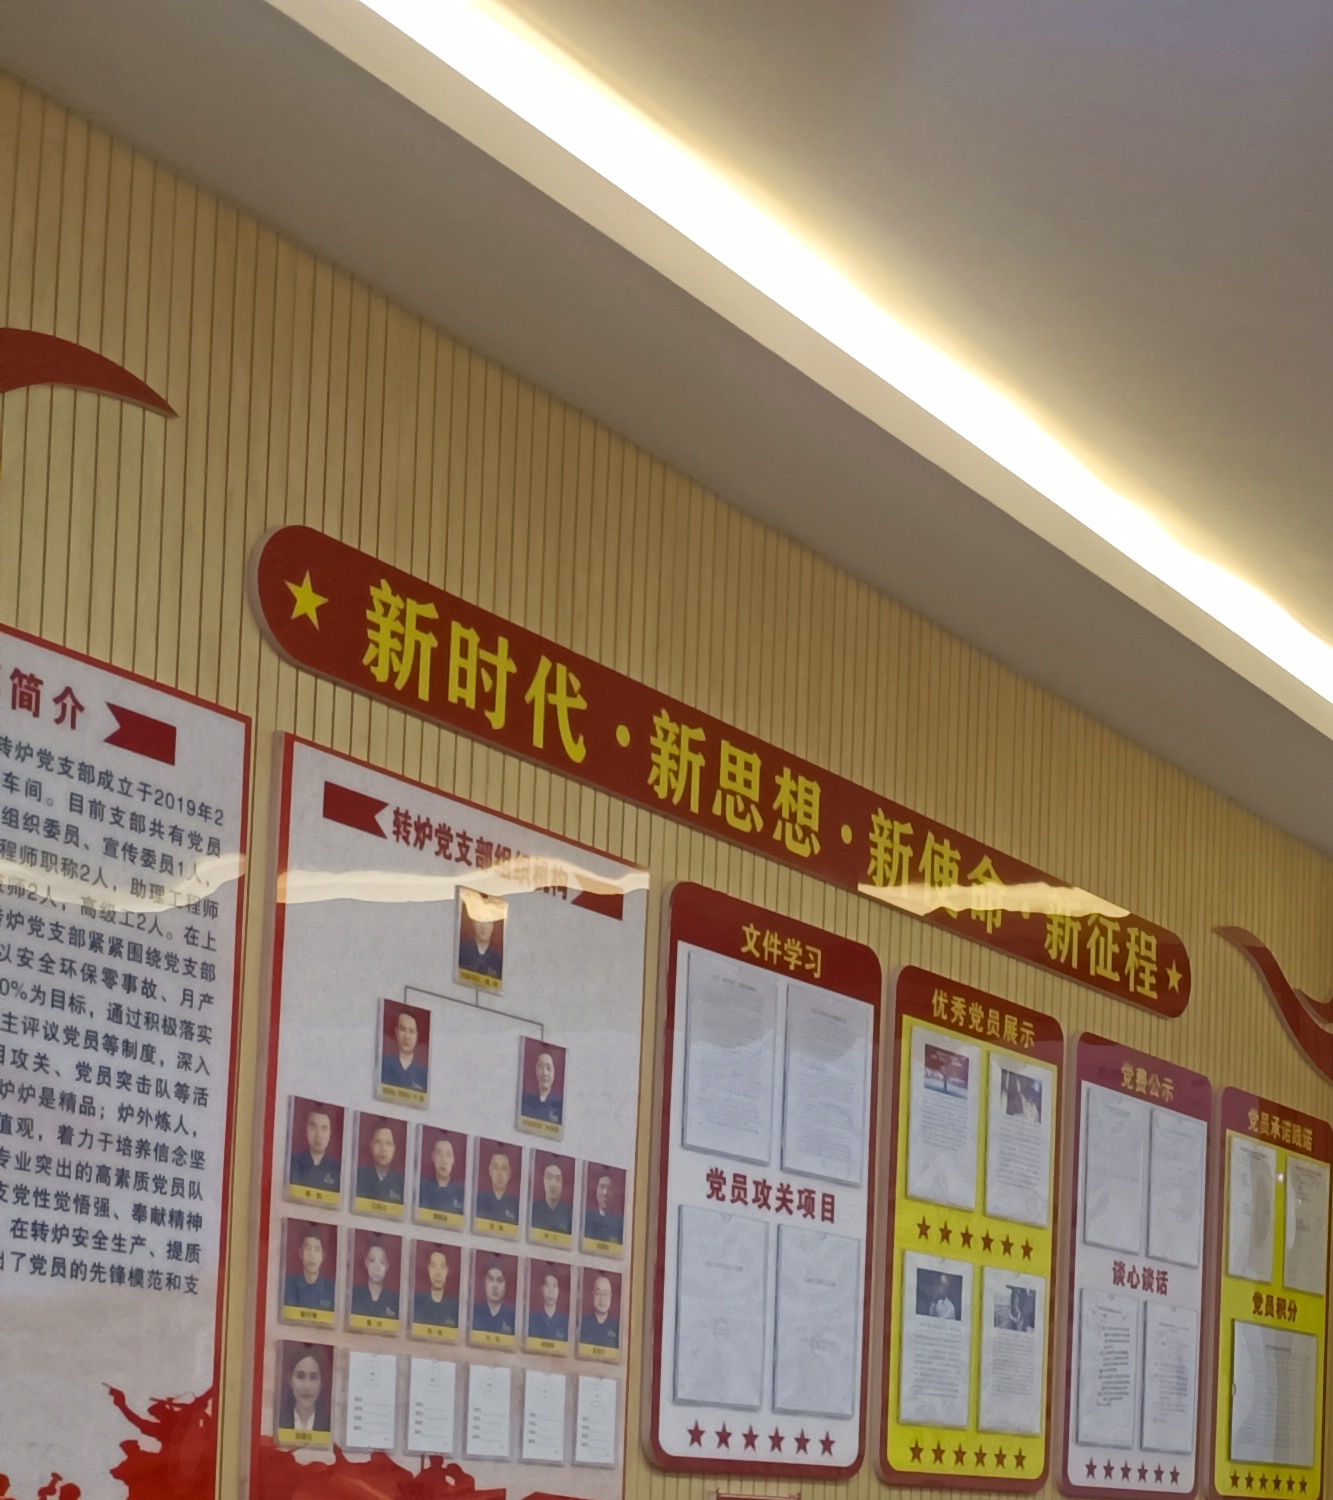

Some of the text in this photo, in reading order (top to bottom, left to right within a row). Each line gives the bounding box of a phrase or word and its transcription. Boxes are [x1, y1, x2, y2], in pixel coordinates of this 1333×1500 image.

[9, 667, 85, 730] 简介
[2, 771, 221, 857] 车间。目前支部共有党员
[0, 907, 216, 983] 炉党支部紧紧围绕党支部
[741, 923, 822, 978] 文件学习
[2, 1011, 210, 1076] 主评议党员等制度，深入
[931, 987, 1036, 1049] 优秀党员展示
[1121, 1062, 1175, 1102] 党费公示
[706, 1167, 836, 1224] 党员攻关项目
[10, 1217, 201, 1264] 在转炉安全生产、提质
[0, 1251, 199, 1295] 了党员的先锋模范和支
[1112, 1260, 1169, 1296] 谈心谈话
[1252, 1291, 1297, 1322] 党员积分
